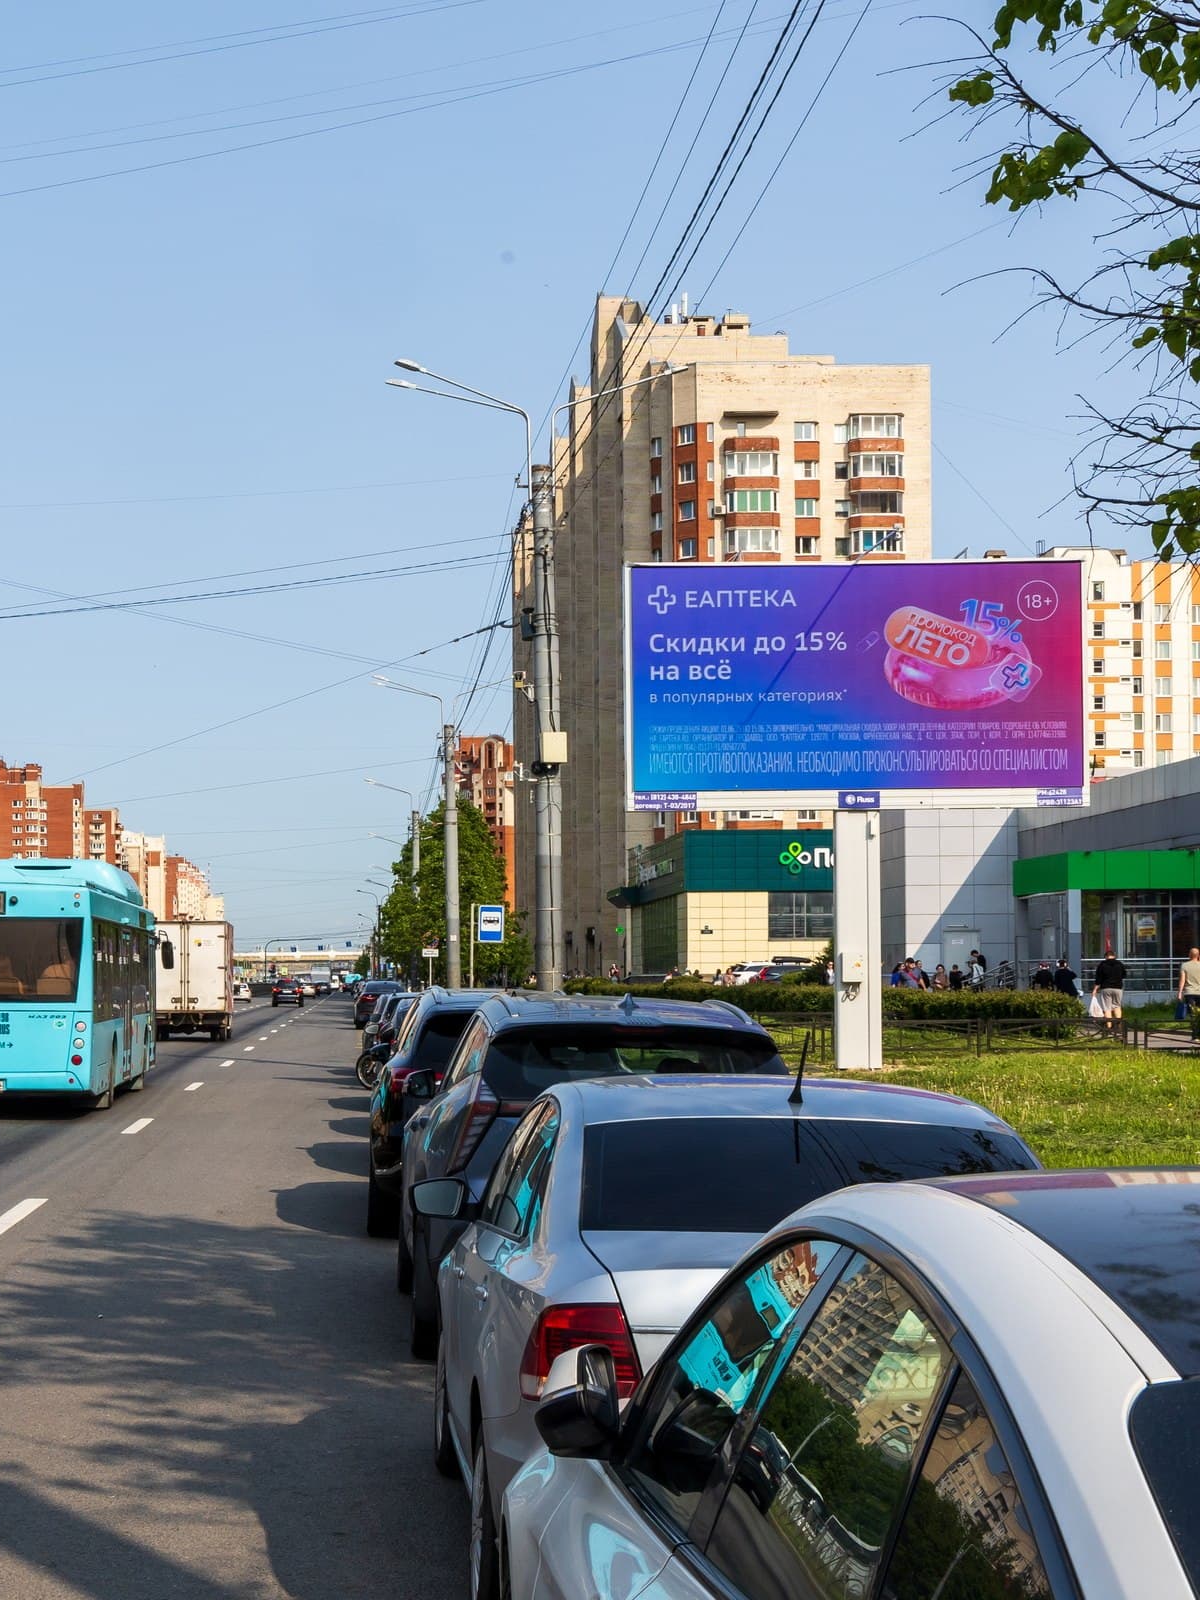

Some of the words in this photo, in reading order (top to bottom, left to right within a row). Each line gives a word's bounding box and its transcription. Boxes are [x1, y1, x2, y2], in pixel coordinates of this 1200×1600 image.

[685, 589, 797, 608] ЕАПТЕКА
[1024, 594, 1052, 609] 18+
[959, 598, 1023, 643] 15%
[650, 634, 745, 655] Скидки
[753, 636, 786, 654] до
[794, 631, 847, 651] 15%
[895, 624, 970, 665] ЛЕТО
[650, 665, 680, 681] на
[689, 659, 731, 680] всё
[650, 694, 657, 703] в
[663, 691, 753, 705] популярных
[649, 752, 693, 774] ИМЕЮТСЯ
[696, 751, 795, 774] ПРОТИВОПОКАЗАНИЯ.
[797, 750, 860, 776] НЕОБХОДИМО
[862, 750, 977, 772] ПРОКОНСУЛЬТИРОВАТЬСЯ
[980, 749, 992, 771] СО
[993, 748, 1068, 774] СПЕЦИАЛИСТОМ
[814, 848, 834, 868] П
